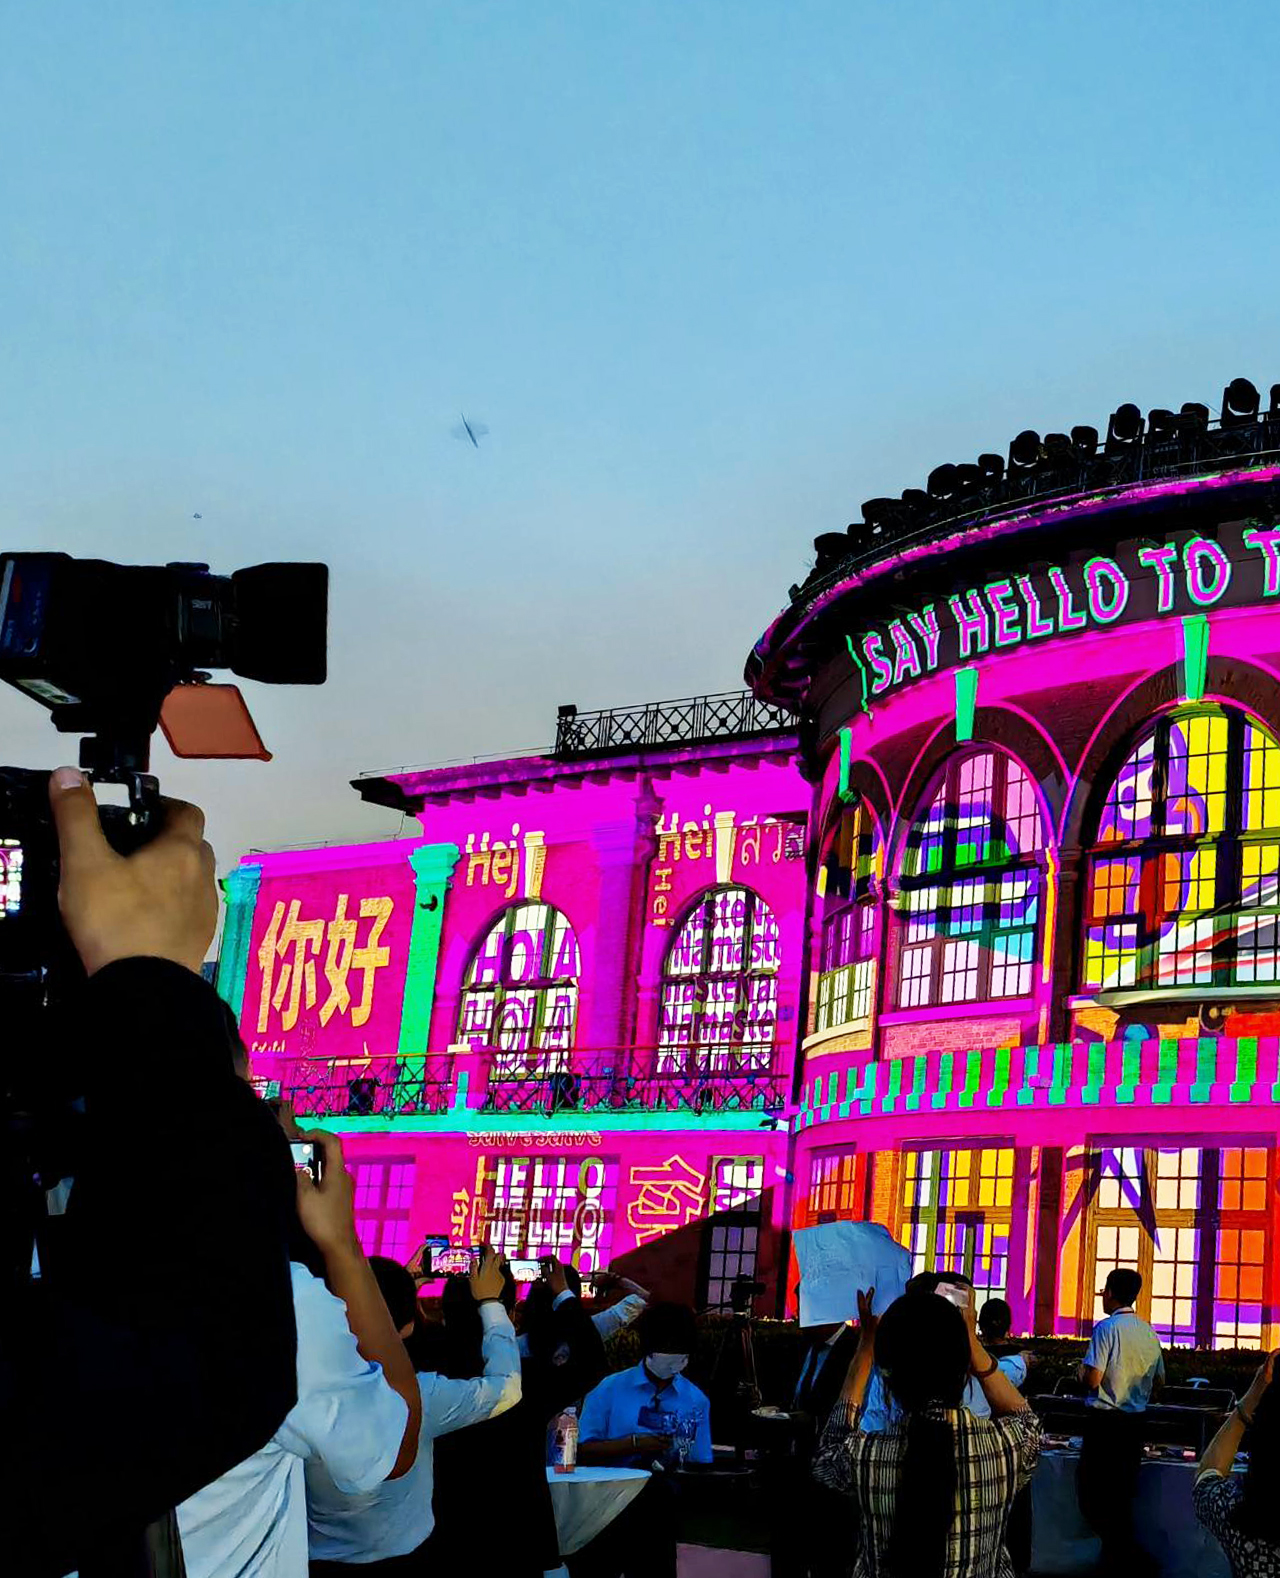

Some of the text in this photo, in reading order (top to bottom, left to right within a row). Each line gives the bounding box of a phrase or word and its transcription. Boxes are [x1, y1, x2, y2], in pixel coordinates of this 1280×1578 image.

[862, 603, 942, 697] SAY
[948, 554, 1129, 664] HELLO
[1139, 536, 1233, 616] TO
[465, 822, 521, 899] Hej
[656, 803, 714, 862] Hei
[256, 893, 394, 1034] 你好
[475, 1155, 606, 1198] HELLO
[470, 1197, 605, 1247] HELLO
